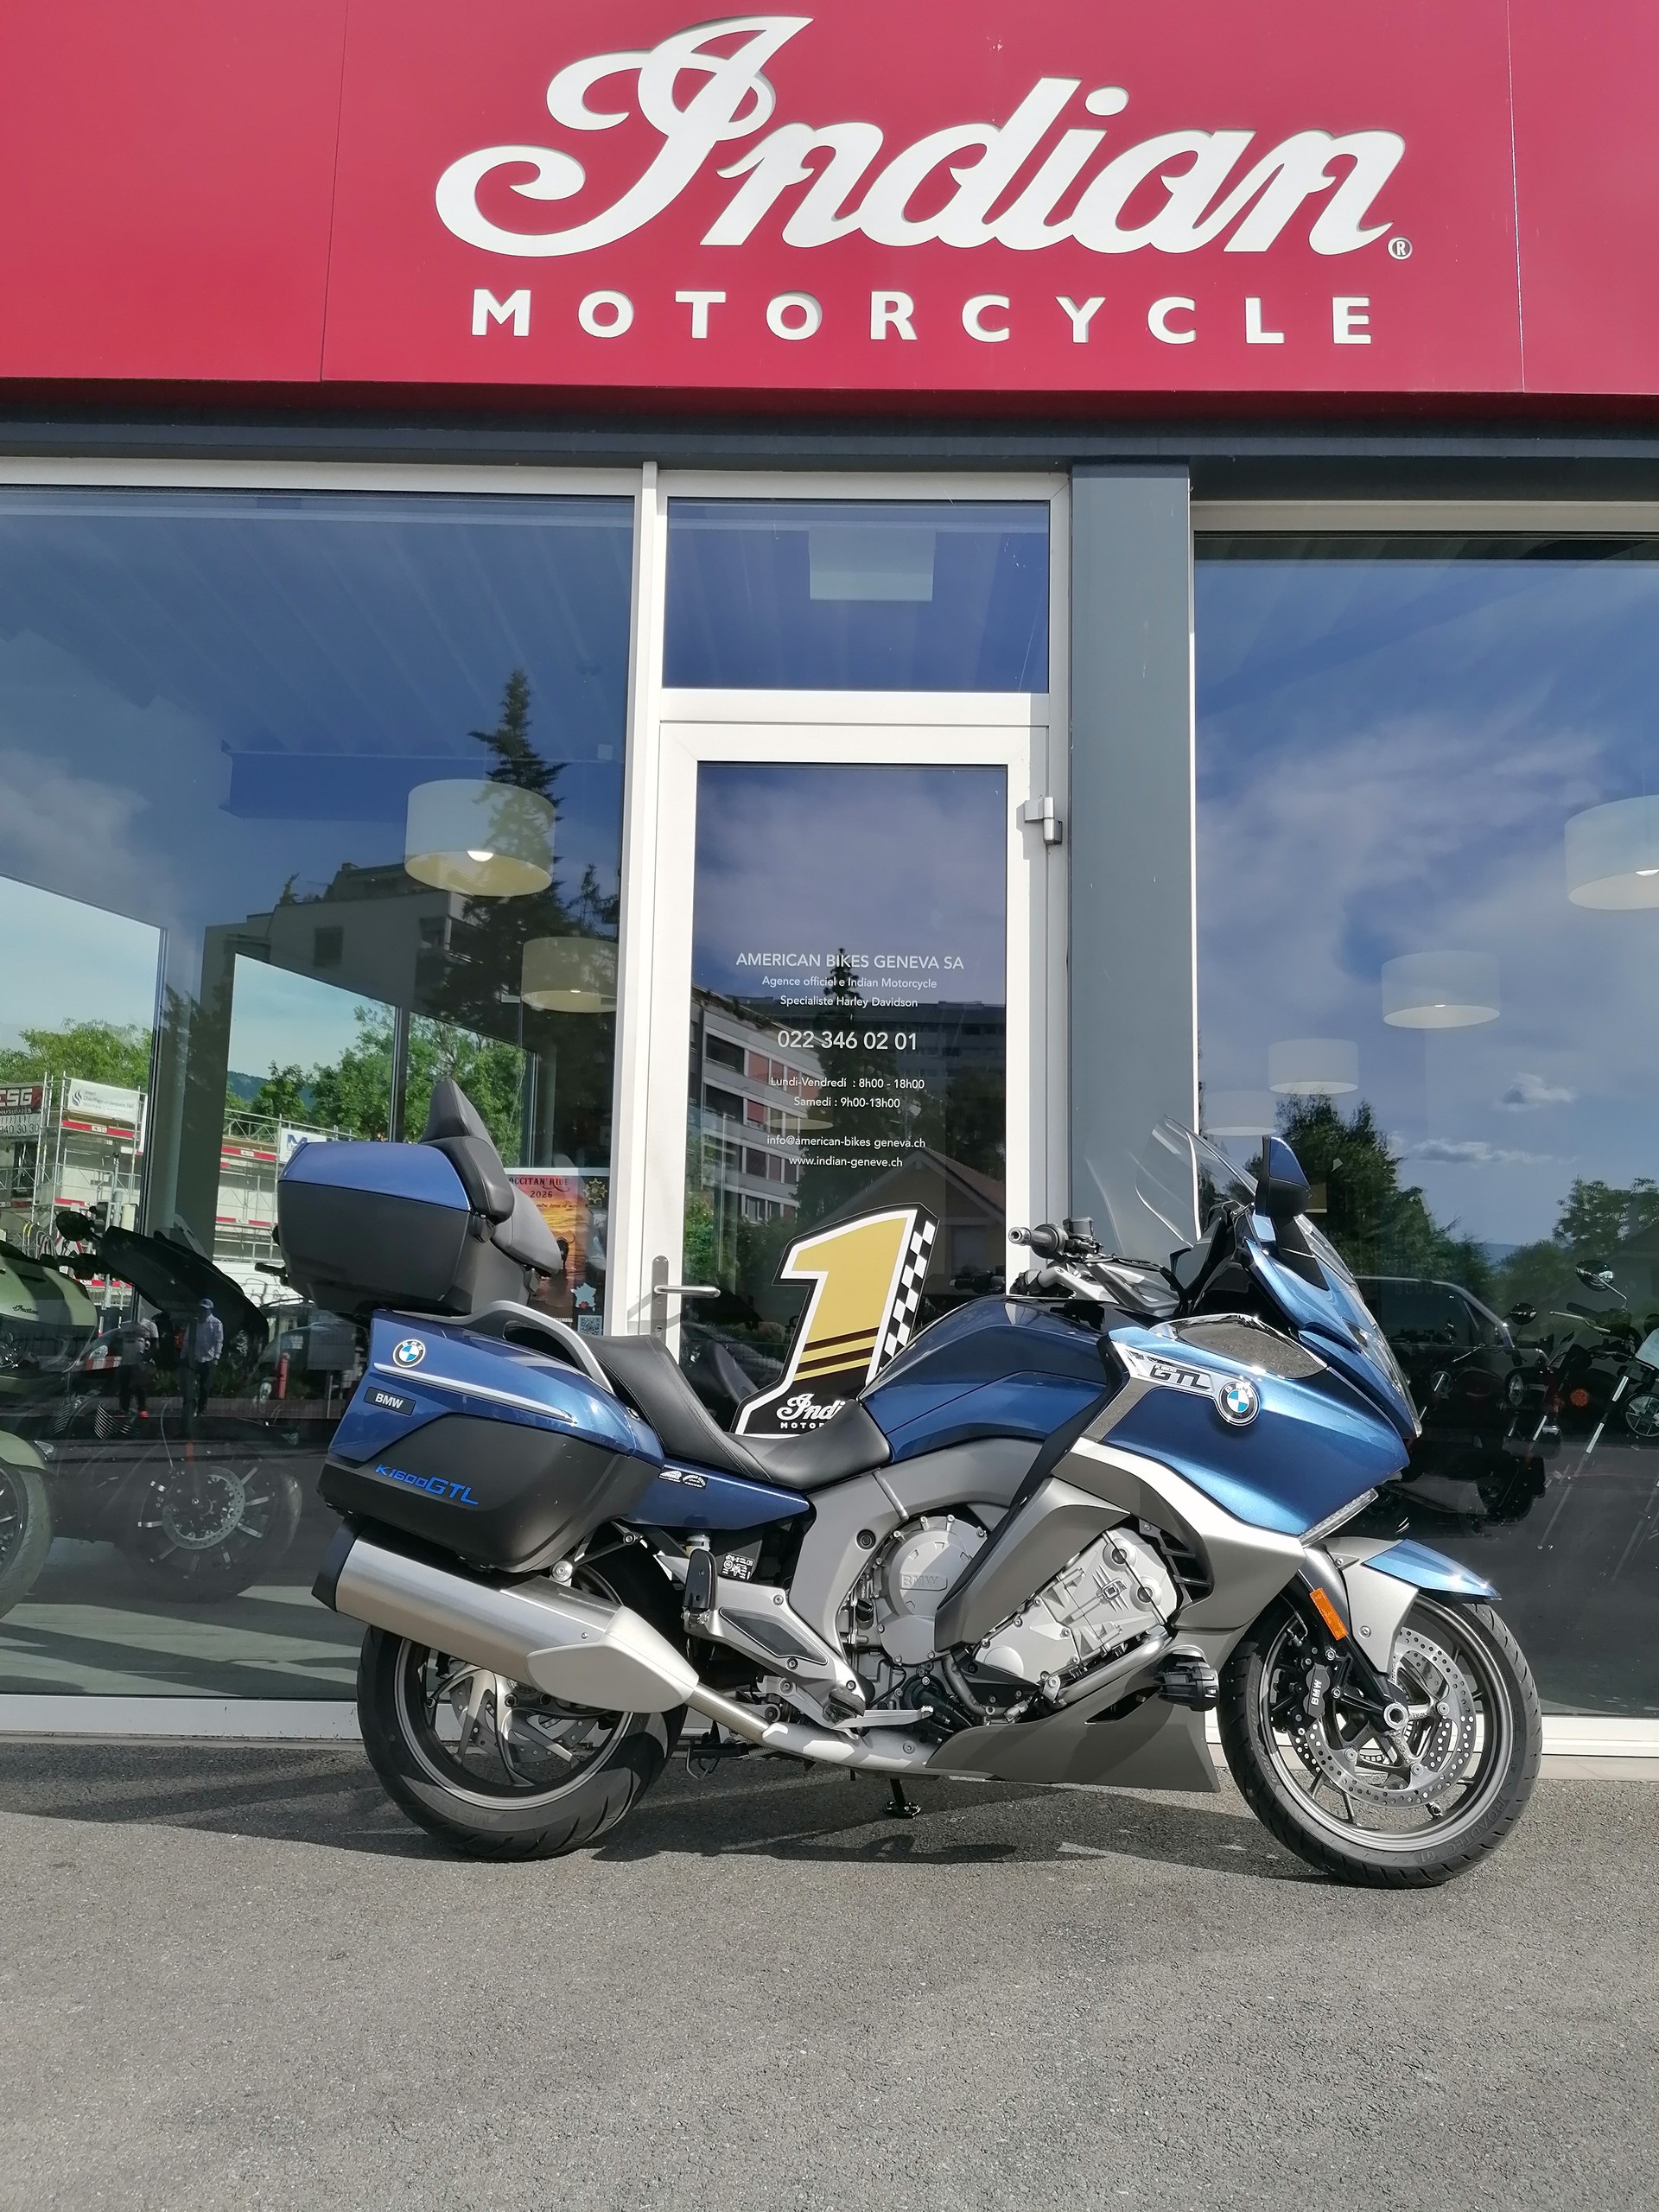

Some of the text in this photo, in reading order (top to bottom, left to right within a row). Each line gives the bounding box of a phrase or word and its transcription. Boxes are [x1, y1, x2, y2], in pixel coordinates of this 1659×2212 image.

[435, 15, 1405, 257] Indian
[471, 288, 1373, 345] MOTORCYCLE
[736, 952, 964, 969] AMERICAN BIKES GENEVA SA
[762, 976, 801, 988] Agence
[848, 977, 879, 988] Indian
[881, 978, 938, 990] Motorcycle
[779, 995, 918, 1009] Specialiste Harley Davidson
[778, 1030, 917, 1051] 022 346 02 01
[858, 1078, 884, 1089] 8h00
[893, 1079, 925, 1090] 18h00
[794, 1096, 832, 1107] Samedi
[841, 1097, 900, 1108] 9h00-13h00
[766, 1135, 926, 1149] info@american-bikes geneva.ch
[788, 1156, 903, 1169] www.indian-geneve.ch
[1149, 1364, 1211, 1390] GTL
[375, 1392, 404, 1409] BMW
[776, 1393, 846, 1421] Indi
[901, 1574, 939, 1589] BMW
[1310, 1679, 1322, 1706] BMW
[1445, 1797, 1507, 1855] ROADTEC
